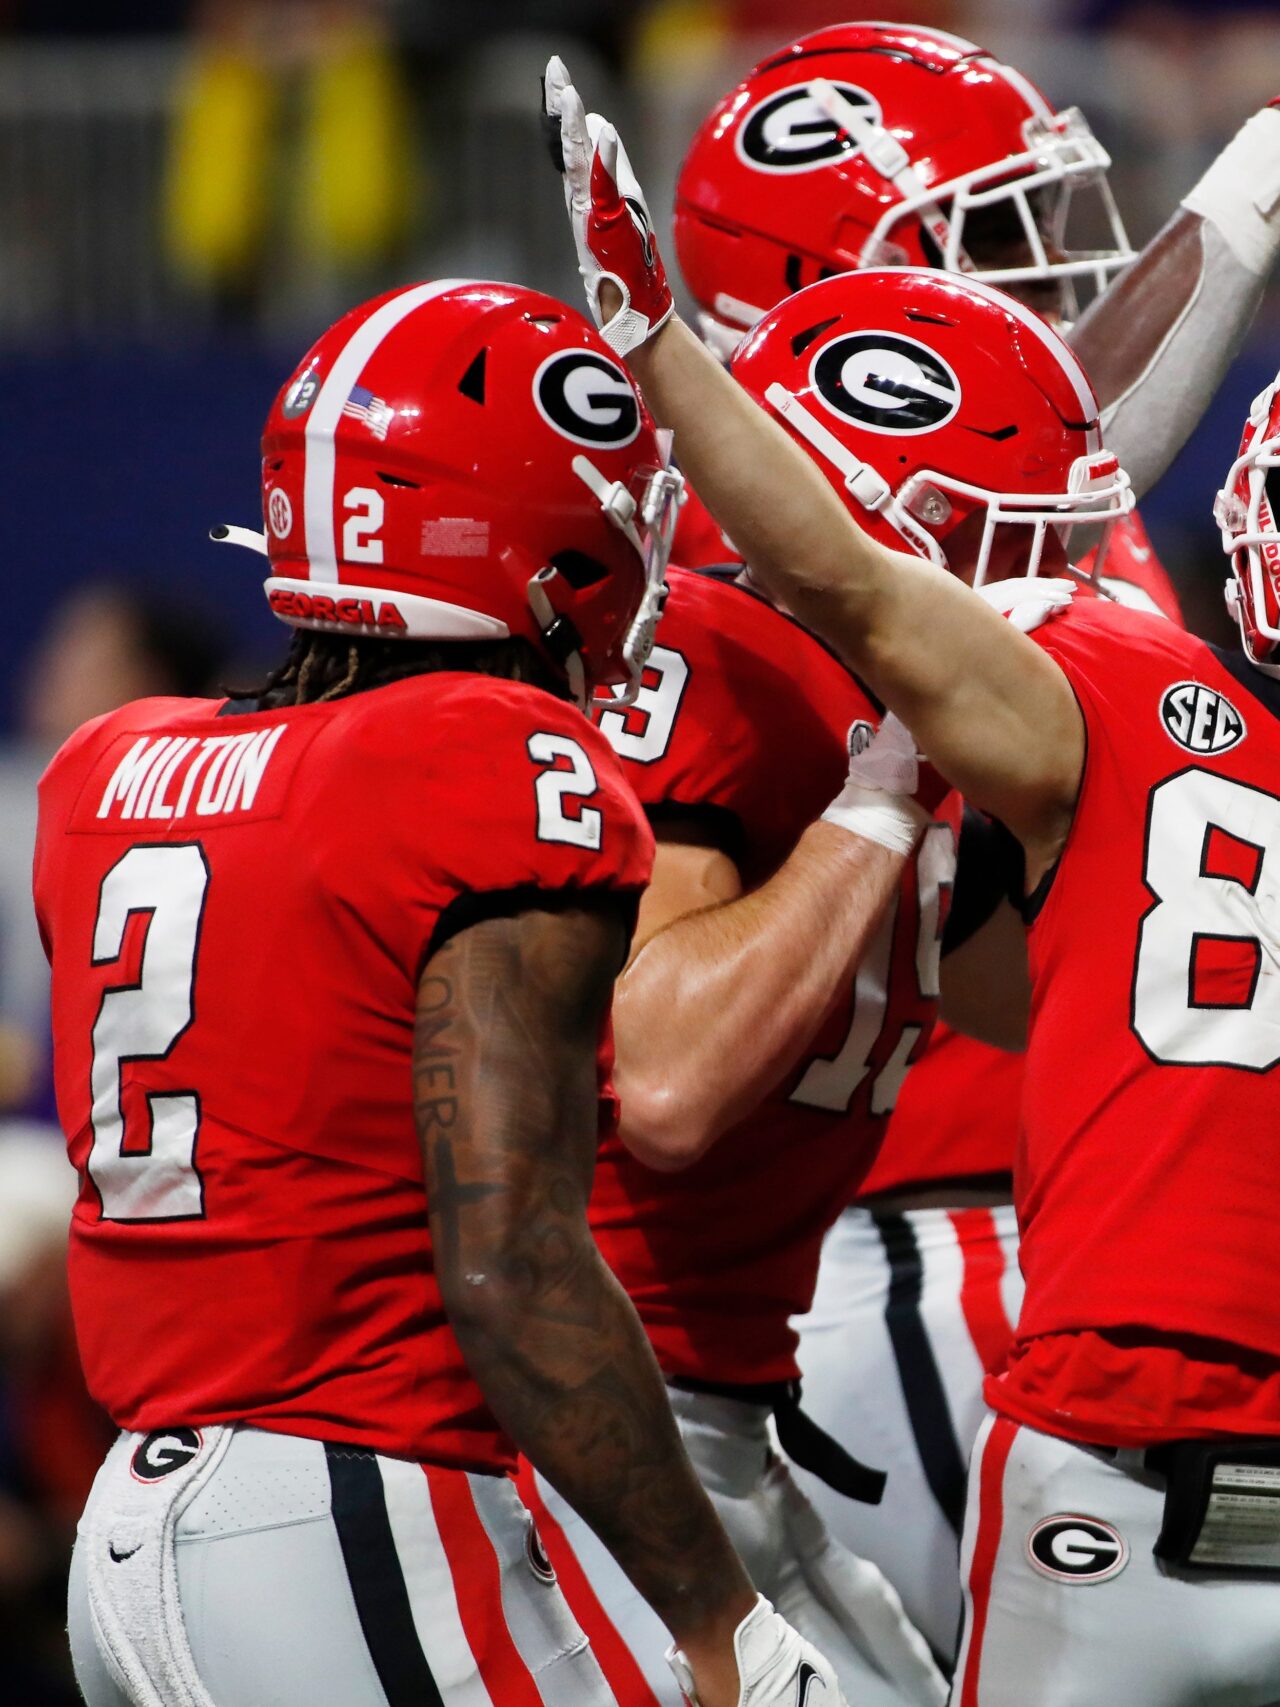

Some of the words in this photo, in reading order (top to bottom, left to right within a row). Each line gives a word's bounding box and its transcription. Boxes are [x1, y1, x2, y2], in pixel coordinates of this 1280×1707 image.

[534, 350, 640, 448] G
[810, 331, 959, 433] G
[343, 487, 385, 564] 2
[269, 588, 408, 629] GEORGIA
[1166, 685, 1241, 750] SEC
[97, 724, 288, 820] MILTON
[526, 730, 603, 852] 2
[88, 841, 212, 1224] 2
[132, 1427, 201, 1480] G
[1029, 1518, 1121, 1577] G
